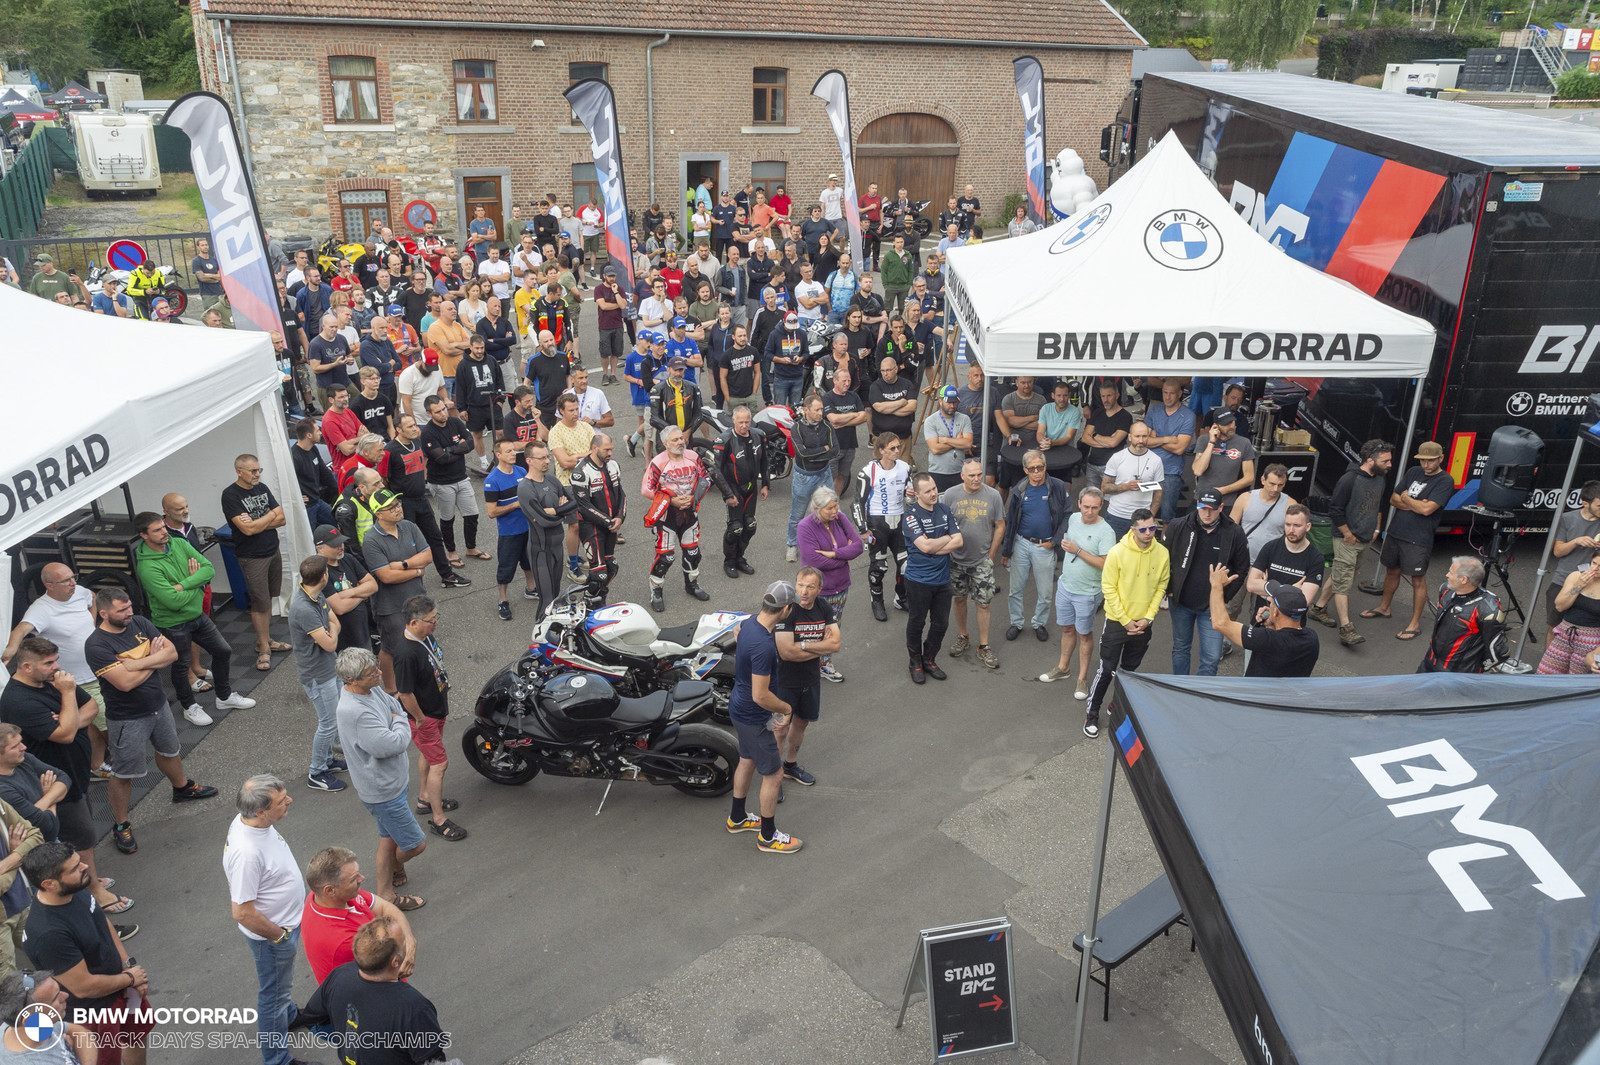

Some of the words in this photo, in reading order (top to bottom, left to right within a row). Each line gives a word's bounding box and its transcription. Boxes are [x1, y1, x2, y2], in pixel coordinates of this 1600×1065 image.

[812, 320, 827, 335] 52
[1036, 332, 1140, 360] BMW
[1150, 331, 1384, 361] MOTORRAD
[471, 364, 494, 388] LA
[365, 406, 386, 420] BMC
[1534, 405, 1571, 415] BMW
[1350, 738, 1586, 912] BMC
[944, 962, 996, 982] STAND
[960, 976, 997, 996] BMC
